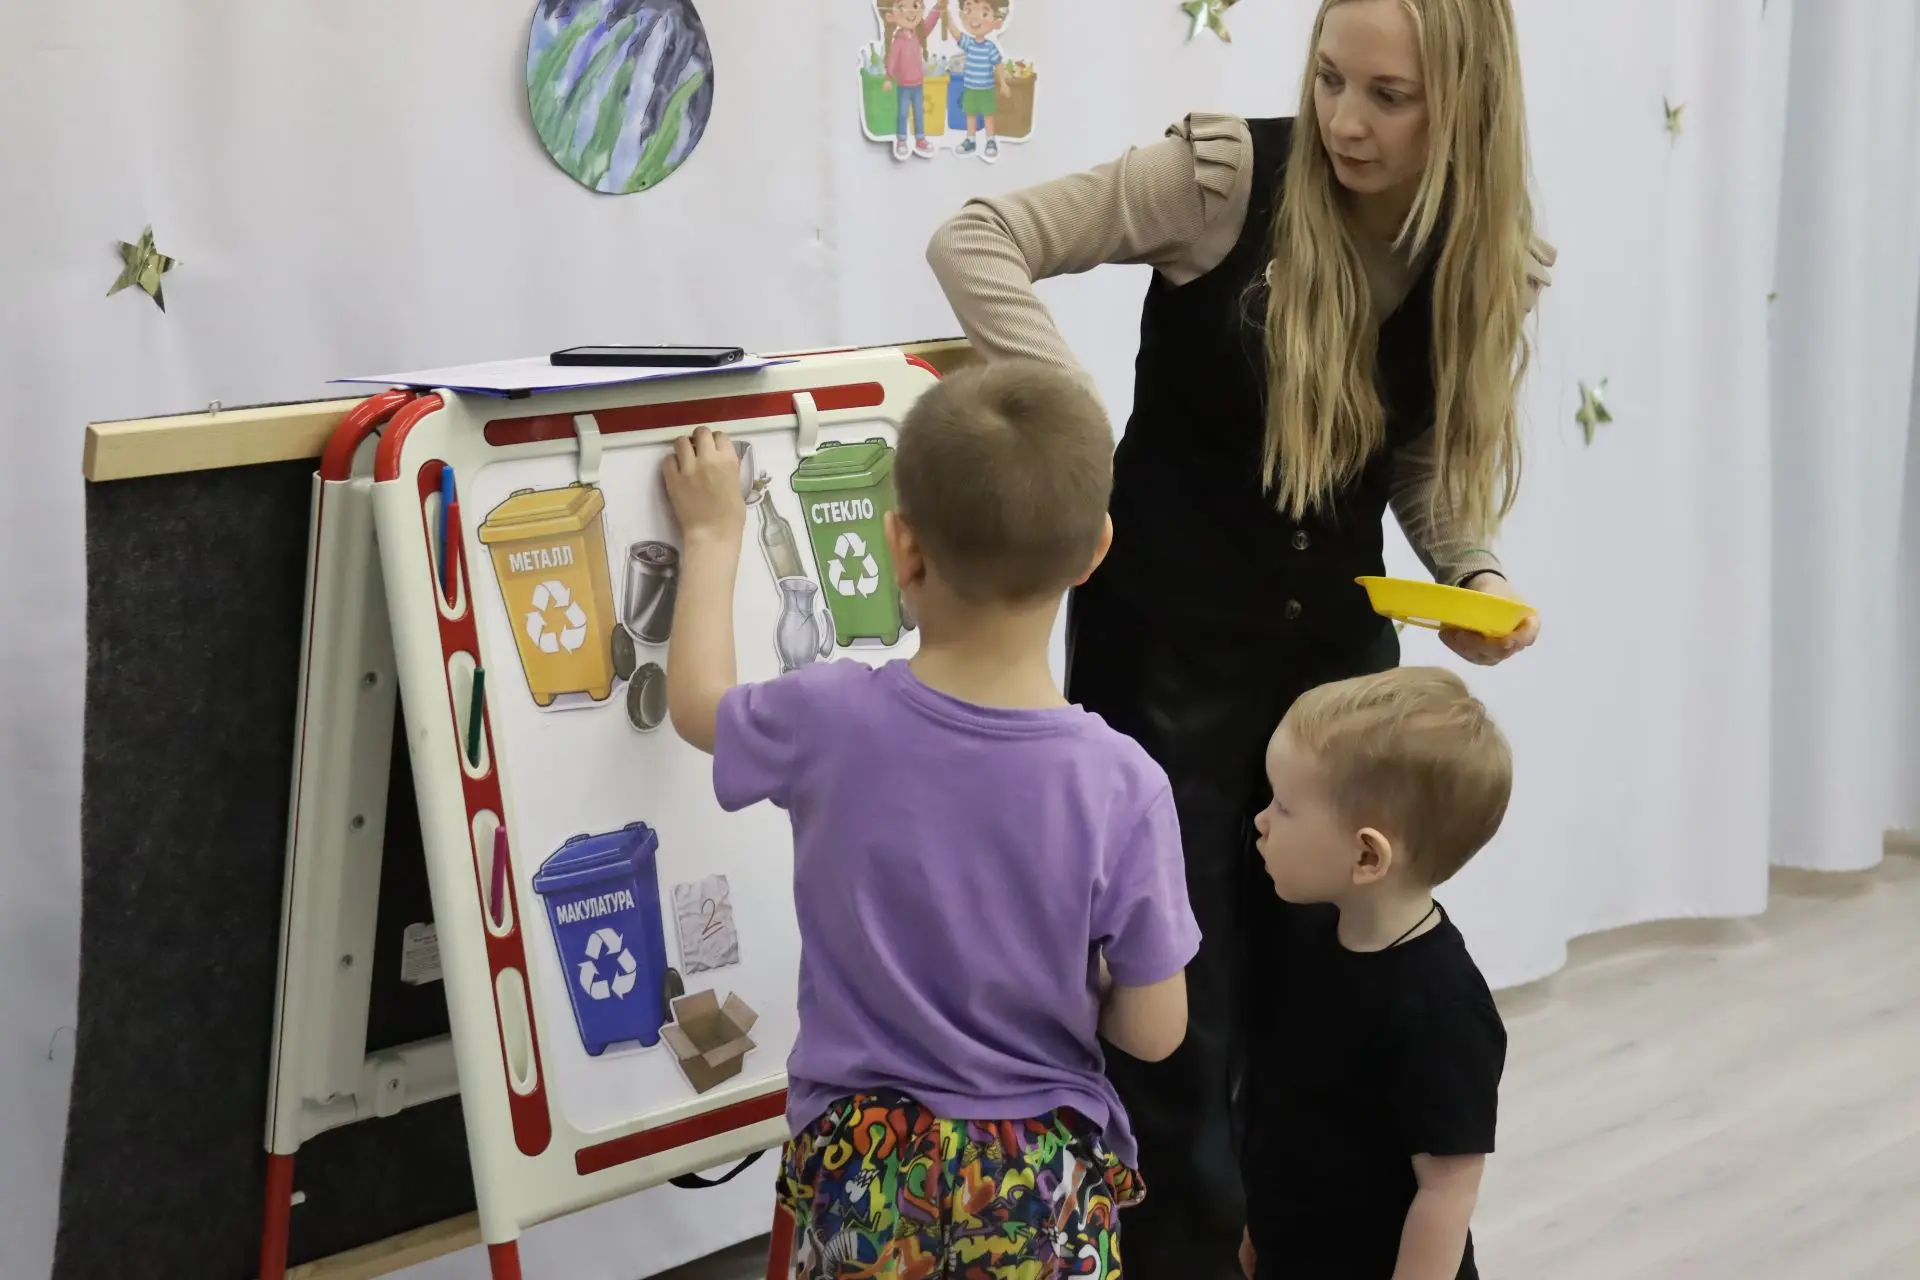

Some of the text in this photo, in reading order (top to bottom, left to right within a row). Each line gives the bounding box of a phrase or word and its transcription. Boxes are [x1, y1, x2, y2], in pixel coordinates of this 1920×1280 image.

[811, 498, 874, 524] СТЕКЛО
[508, 545, 574, 573] МЕТАЛЛ
[556, 889, 635, 925] МАКУЛАТУРА
[701, 898, 723, 937] 2
